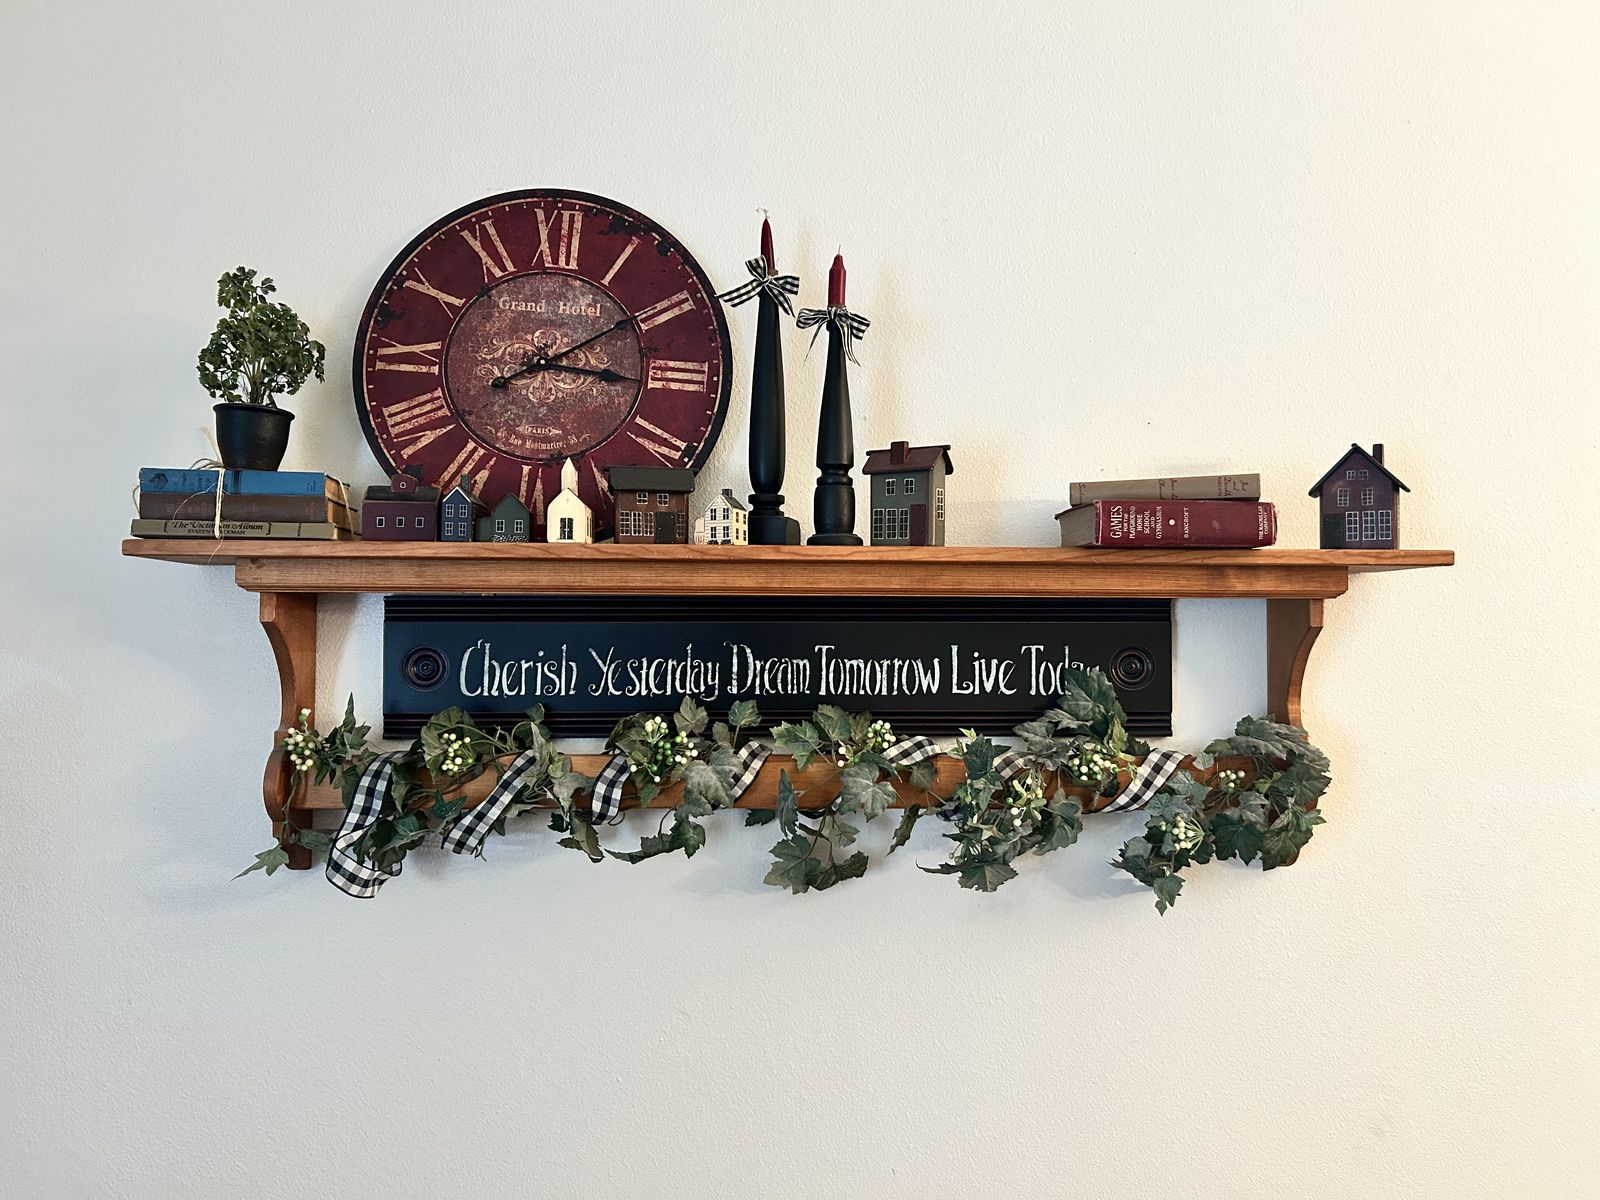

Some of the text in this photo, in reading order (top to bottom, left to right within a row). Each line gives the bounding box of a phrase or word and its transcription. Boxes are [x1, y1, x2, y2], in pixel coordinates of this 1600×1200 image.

[460, 219, 517, 283] XI
[532, 208, 584, 270] XII
[403, 267, 466, 319] X
[499, 297, 601, 316] Grand Hotel
[634, 290, 696, 332] II
[375, 337, 441, 376] IX
[647, 358, 709, 393] III
[527, 427, 551, 436] PARIS
[172, 520, 190, 529] The
[1110, 505, 1123, 538] GAMES
[459, 639, 1100, 701] Cherish Yesterday Dream Tomorrow Live Tod
